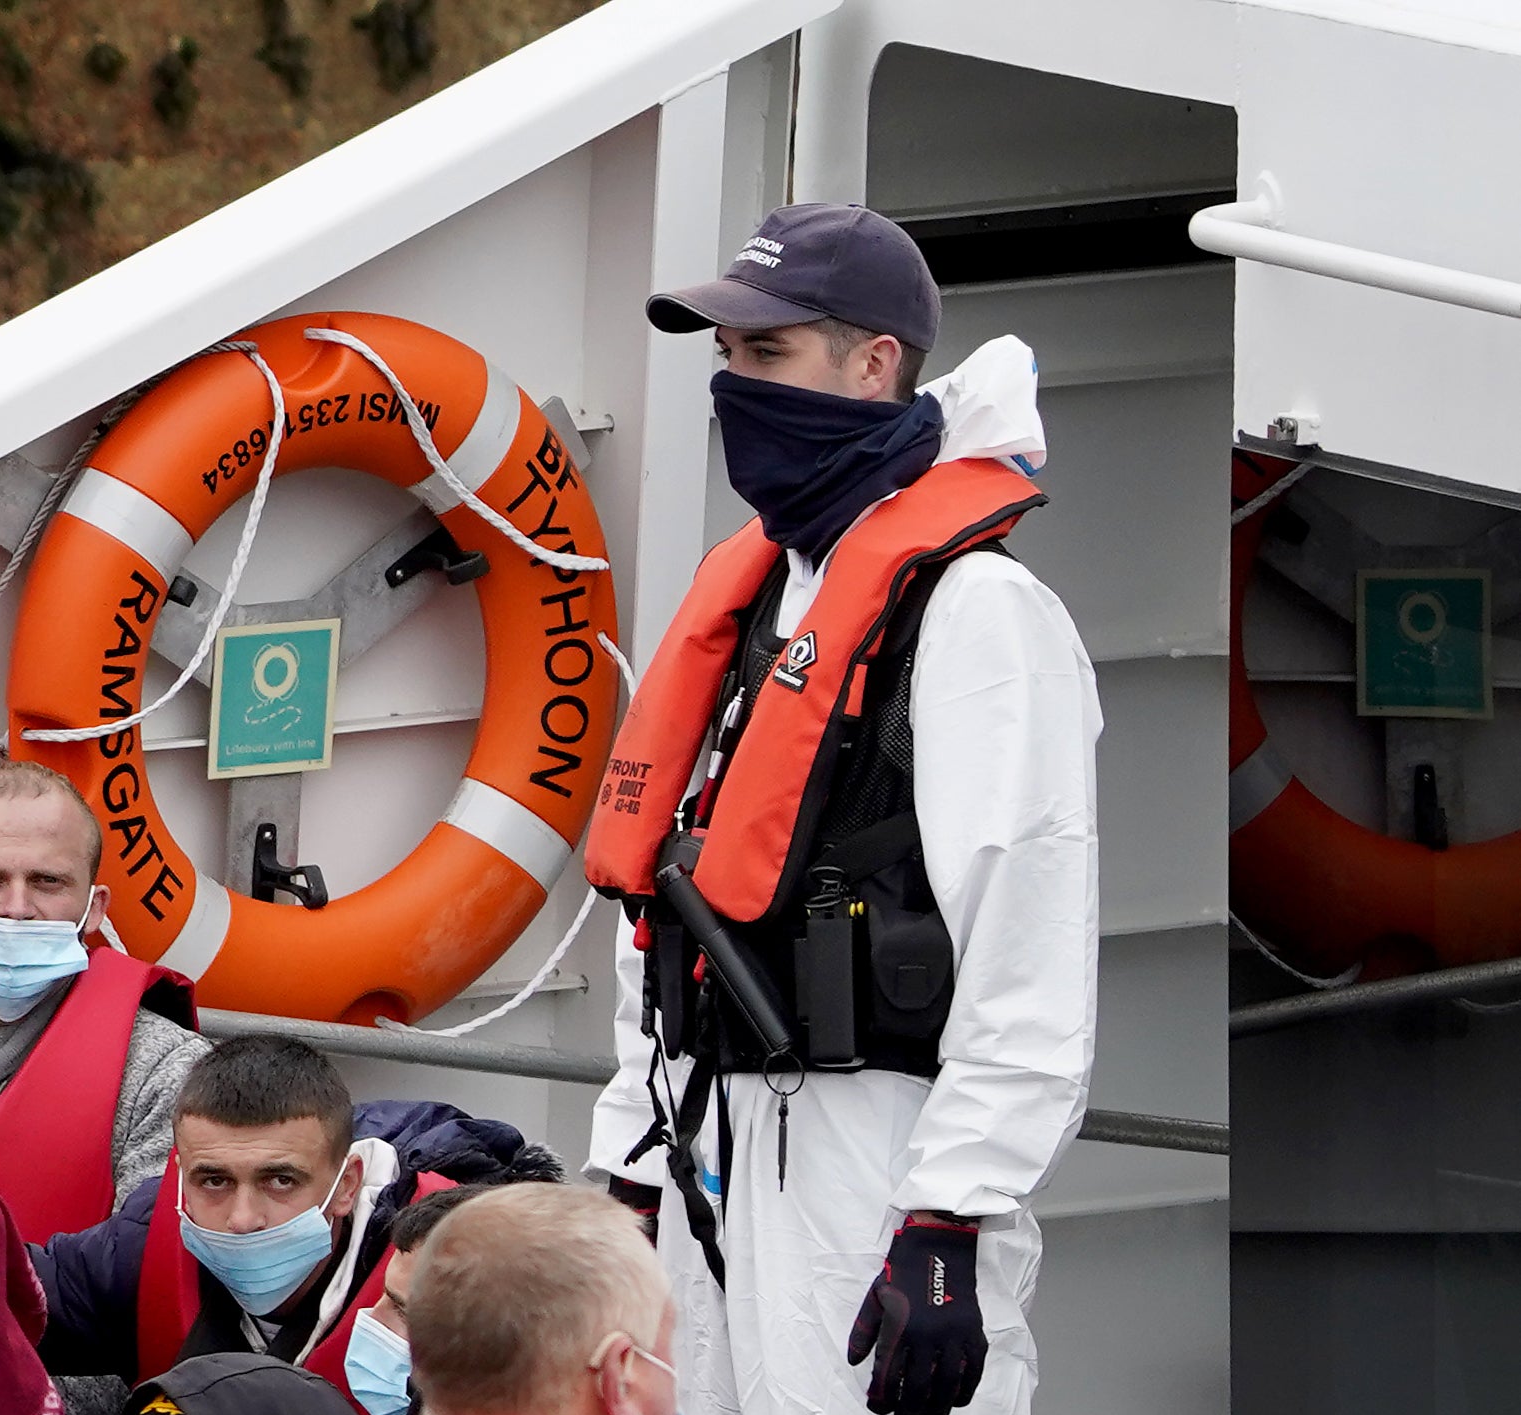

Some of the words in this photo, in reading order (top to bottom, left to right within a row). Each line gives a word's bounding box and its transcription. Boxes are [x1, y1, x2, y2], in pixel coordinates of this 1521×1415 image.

[358, 392, 441, 433] MMSI
[506, 459, 595, 799] TYPHOON
[99, 570, 184, 922] RAMSGATE
[226, 743, 272, 756] Lifebuoy
[274, 740, 296, 752] with
[297, 737, 317, 749] line
[932, 1255, 946, 1306] MUSTO
